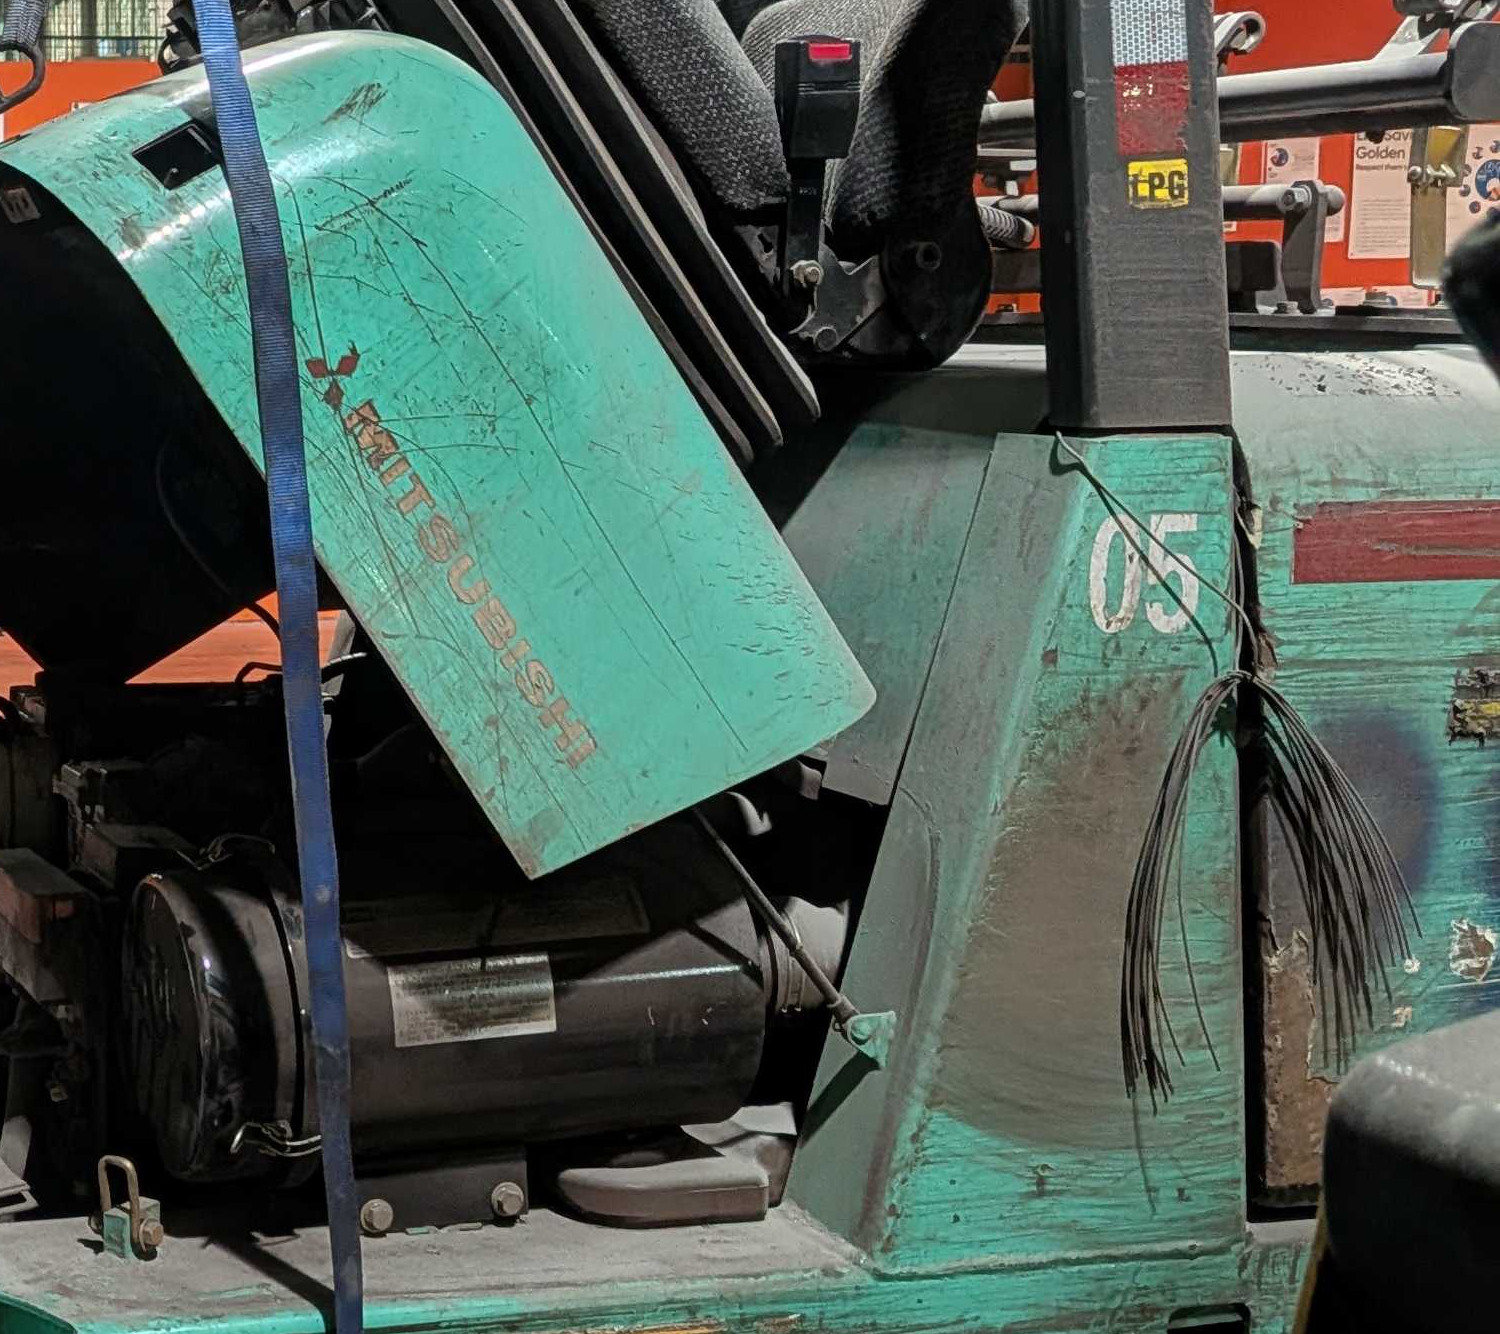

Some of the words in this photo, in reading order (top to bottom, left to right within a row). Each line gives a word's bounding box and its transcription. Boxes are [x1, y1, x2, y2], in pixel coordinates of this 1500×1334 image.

[1356, 146, 1406, 159] Golden
[343, 398, 598, 769] MITSUBISHI
[1089, 513, 1199, 634] 05
